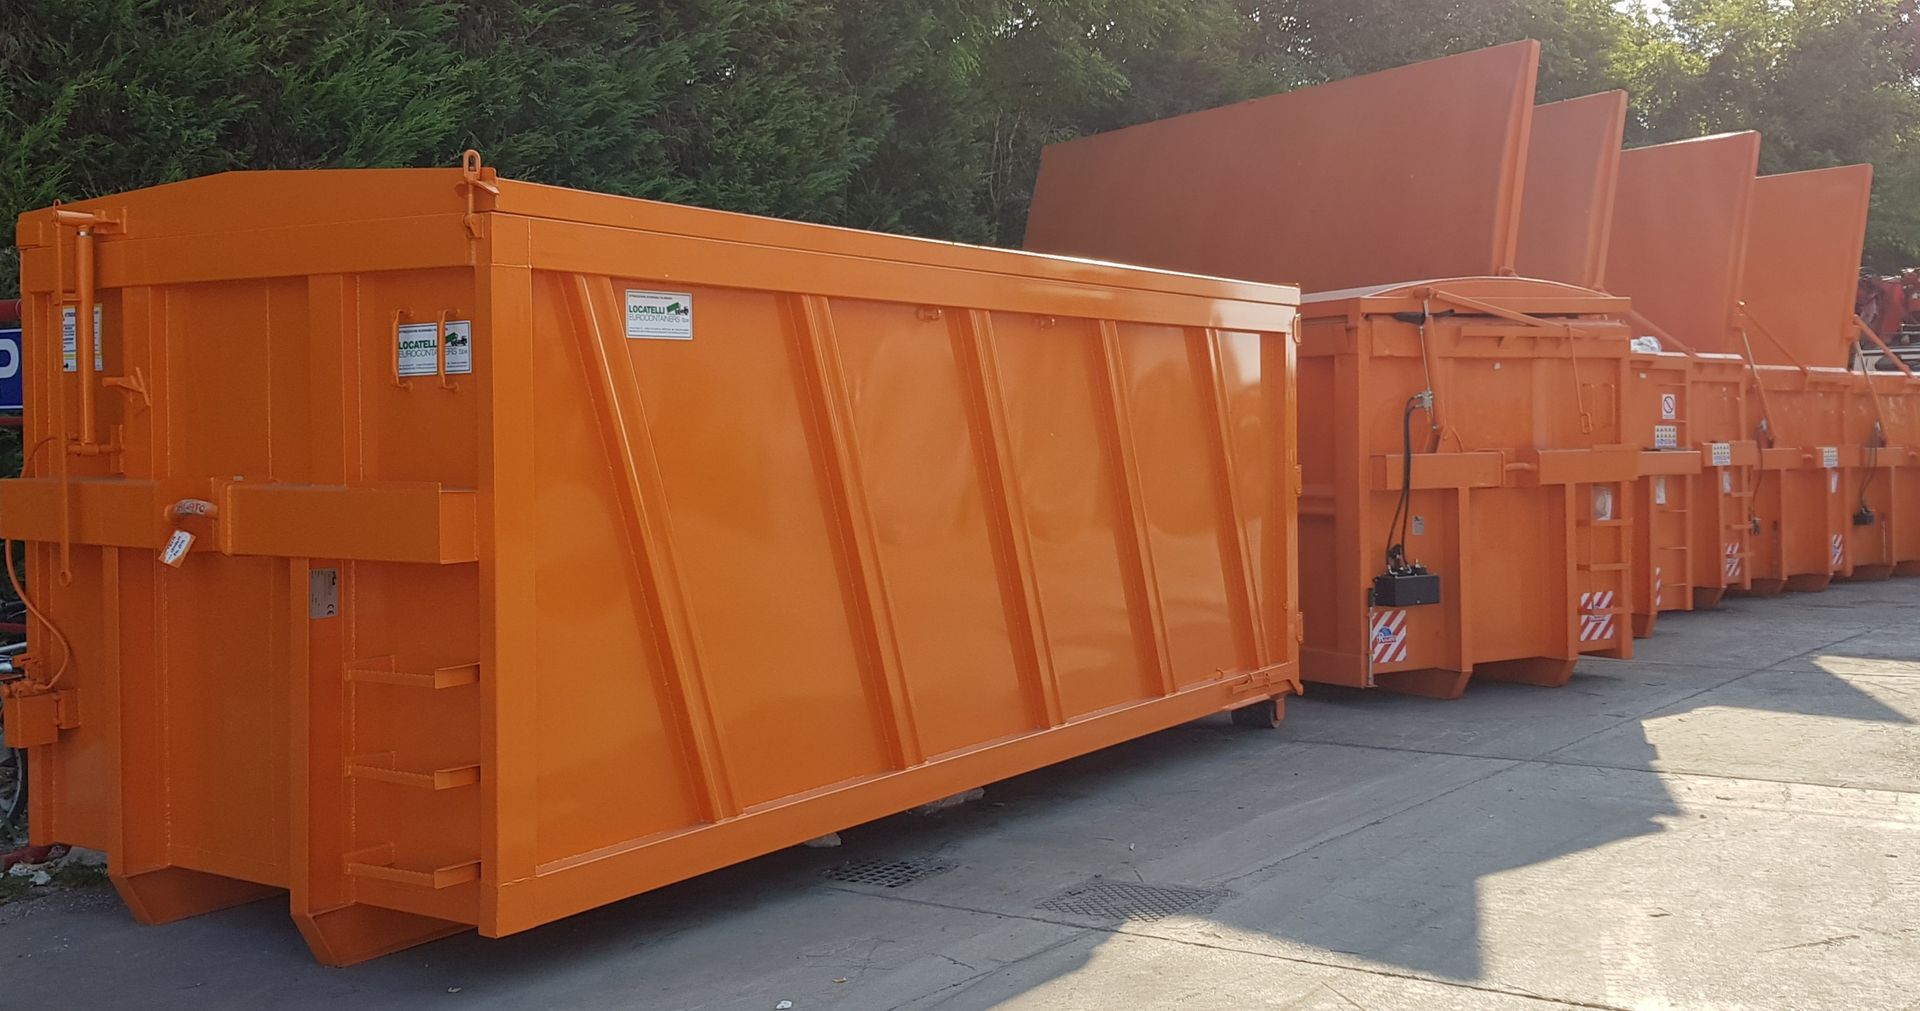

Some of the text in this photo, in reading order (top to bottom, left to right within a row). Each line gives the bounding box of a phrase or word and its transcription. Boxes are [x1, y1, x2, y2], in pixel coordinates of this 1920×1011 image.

[629, 305, 665, 314] LOCATELLI
[629, 314, 680, 323] EUROCONTAINERS
[399, 339, 437, 350] LOCATELL
